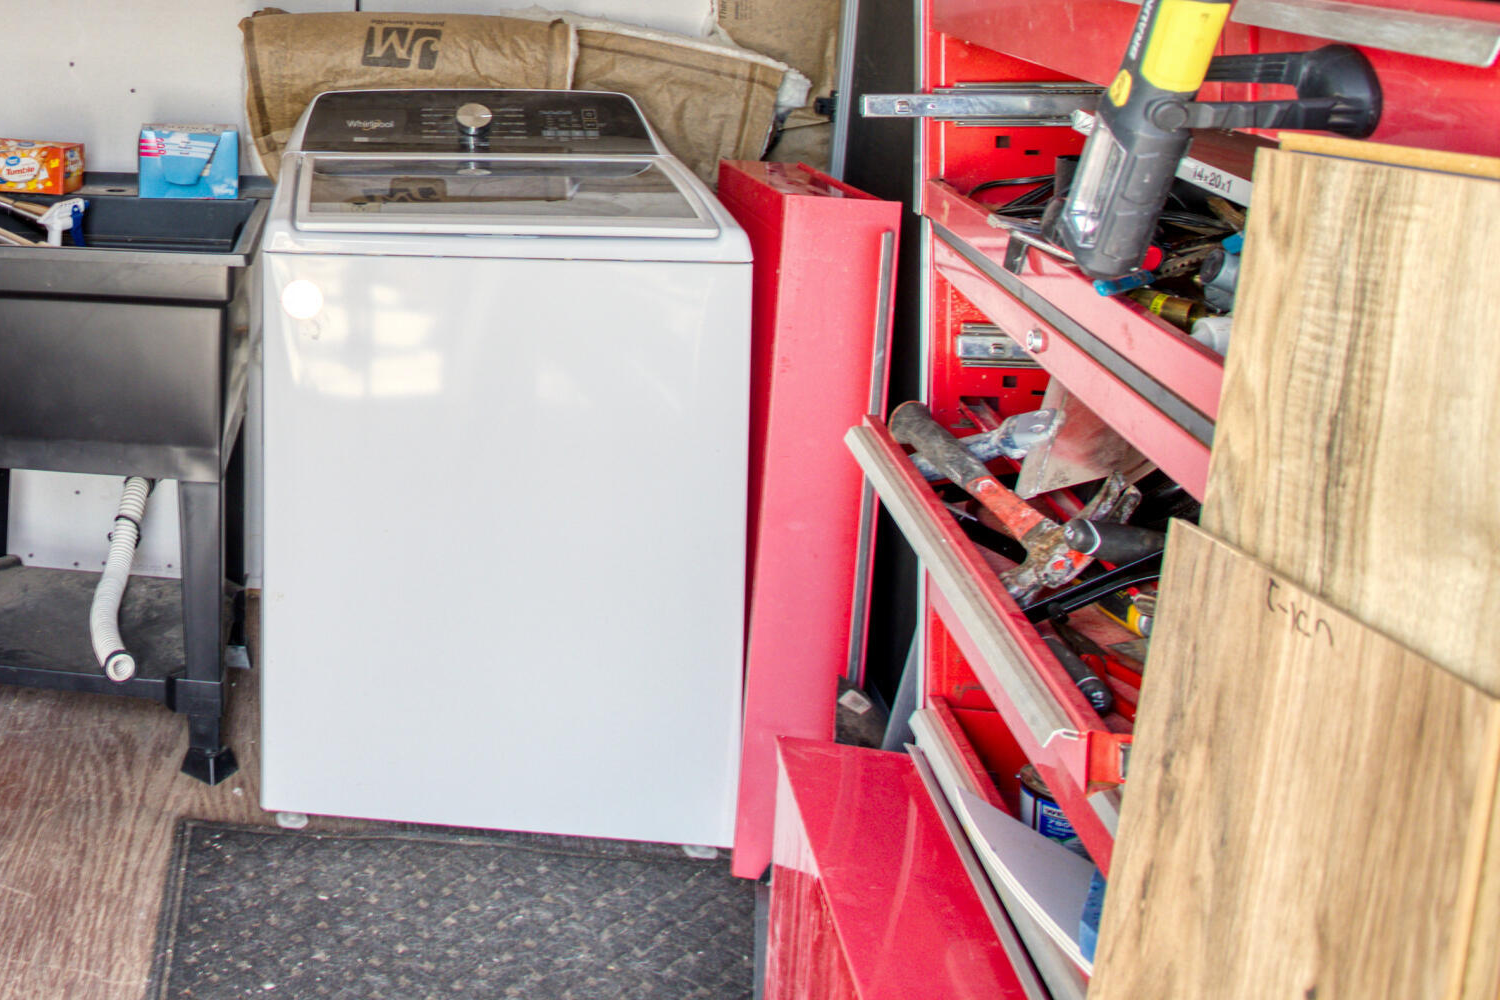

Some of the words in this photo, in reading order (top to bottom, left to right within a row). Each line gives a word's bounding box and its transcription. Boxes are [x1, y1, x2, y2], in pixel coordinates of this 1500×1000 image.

[361, 26, 443, 70] JM
[346, 119, 395, 131] Whirlpool
[5, 166, 36, 176] Tumble
[1192, 165, 1233, 194] 14x20x1
